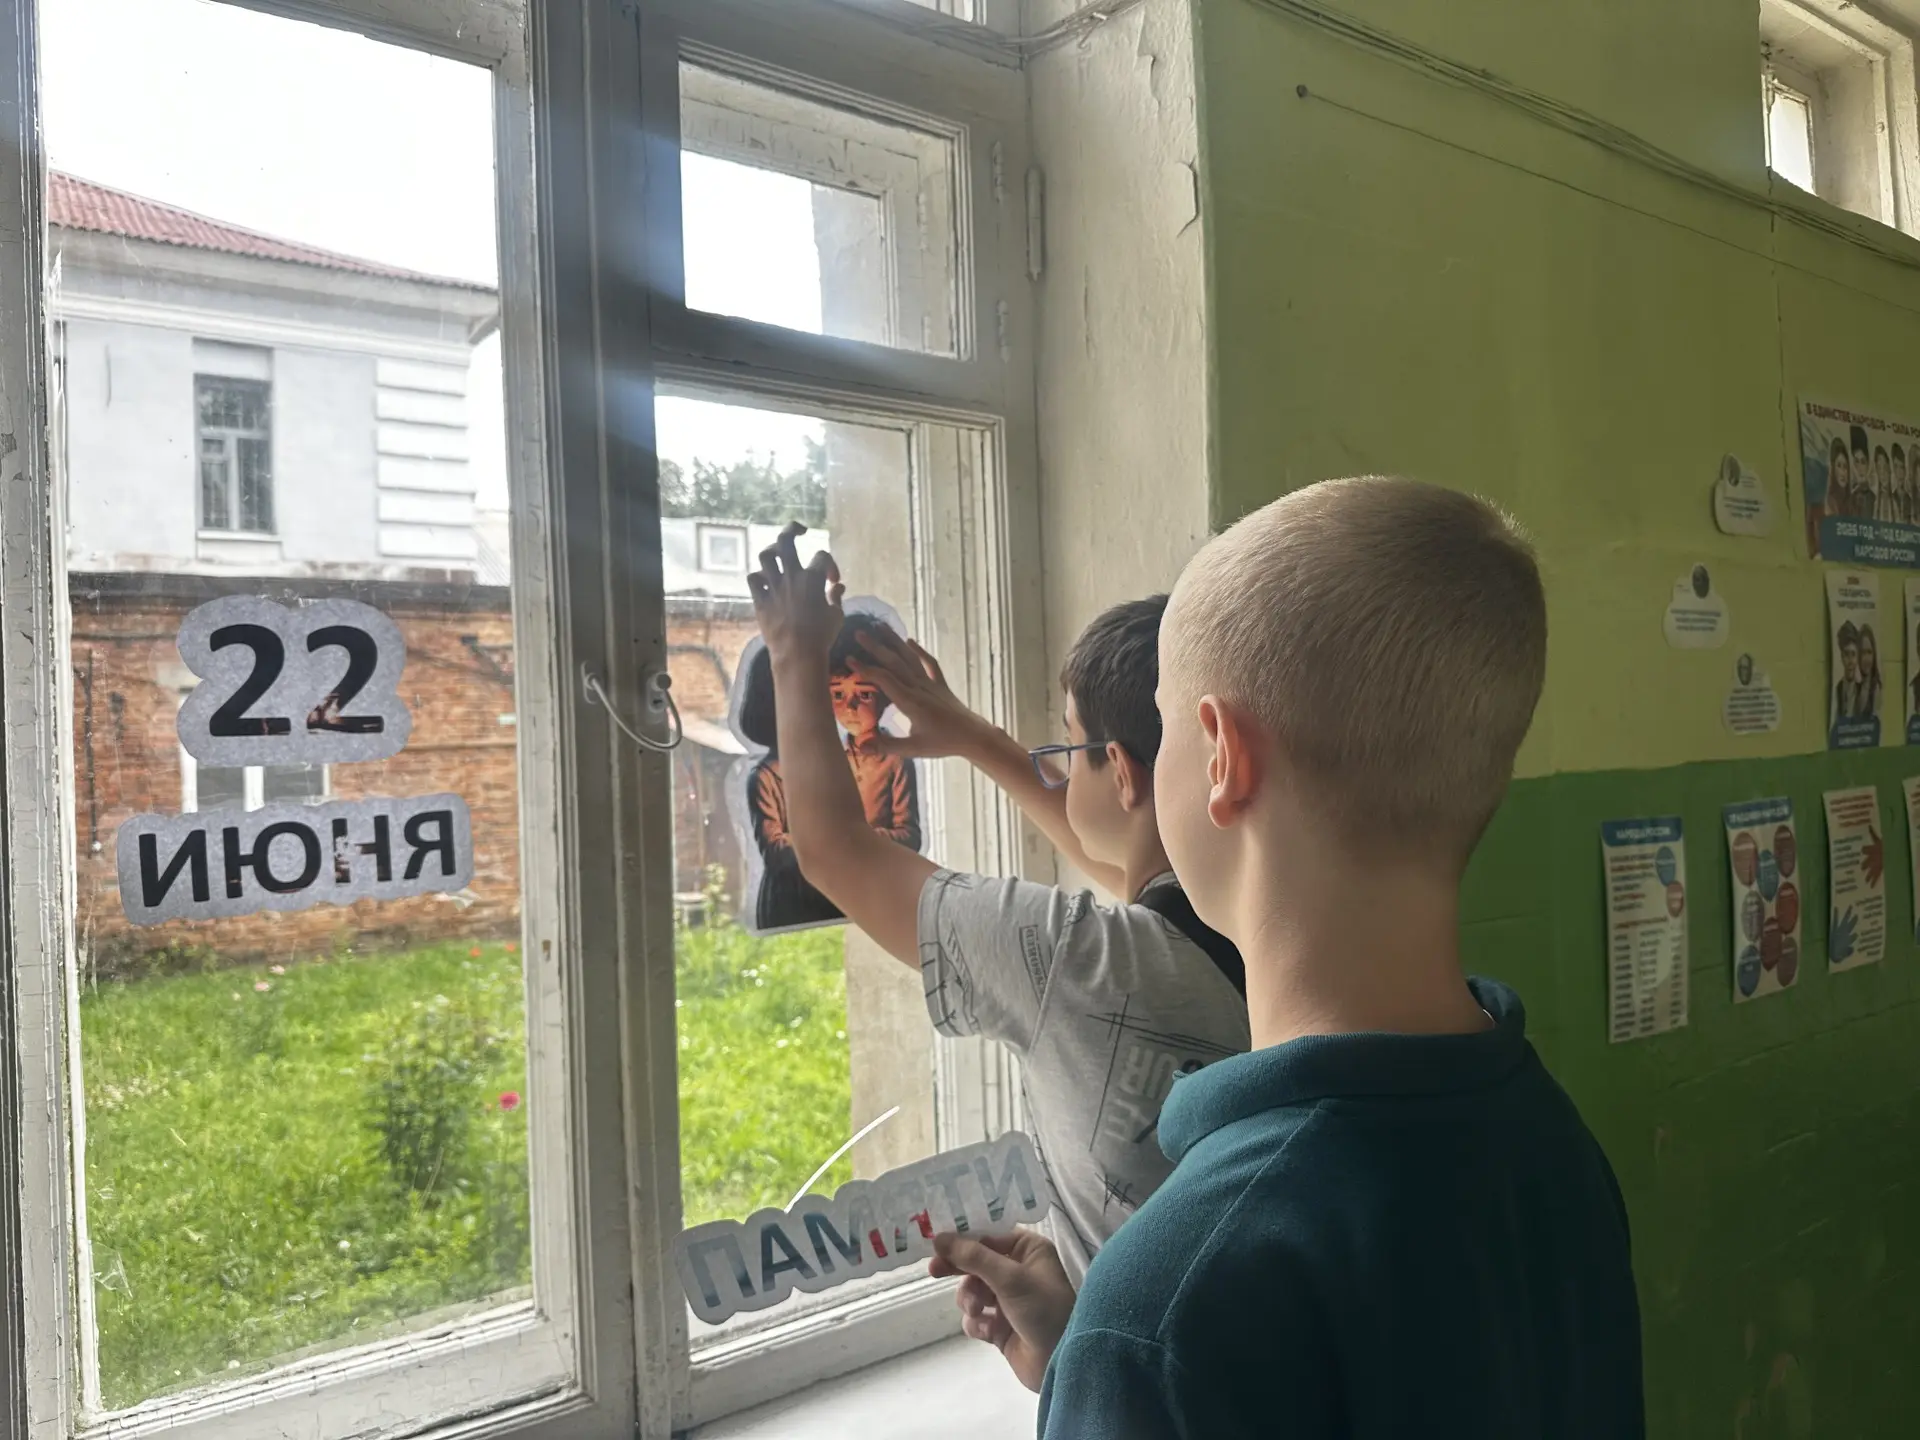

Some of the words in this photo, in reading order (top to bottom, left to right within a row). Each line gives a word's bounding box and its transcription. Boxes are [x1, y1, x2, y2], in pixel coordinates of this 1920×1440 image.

[209, 624, 384, 737] 22
[138, 810, 457, 908] ИЮНЯ
[687, 1144, 1037, 1308] ПАМЯТИ
